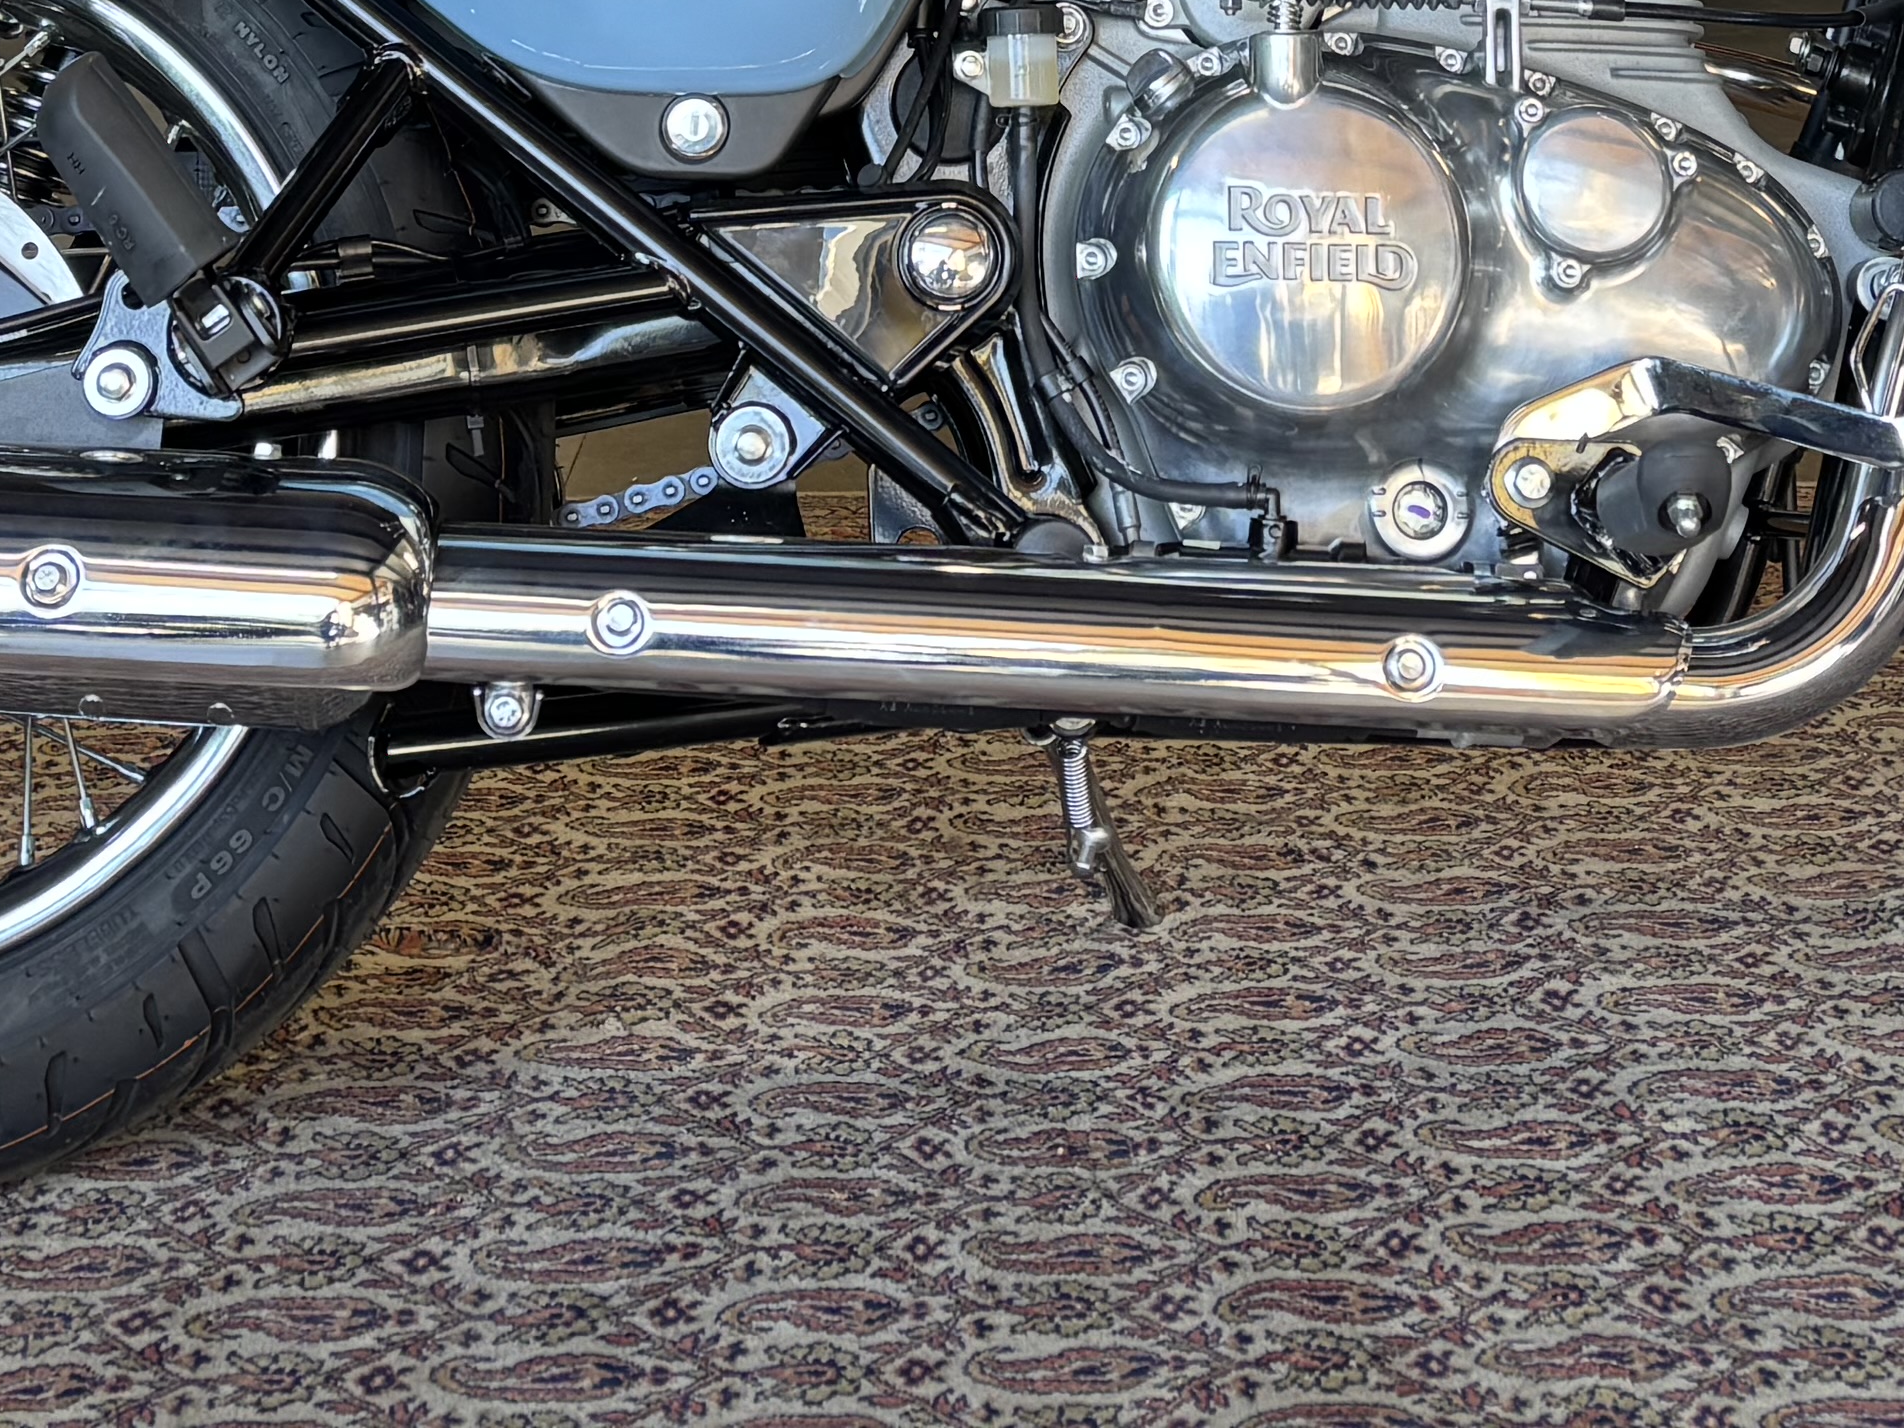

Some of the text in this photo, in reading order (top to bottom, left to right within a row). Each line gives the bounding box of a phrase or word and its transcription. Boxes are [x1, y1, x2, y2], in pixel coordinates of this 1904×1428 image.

[233, 20, 291, 85] NYLON
[1225, 185, 1396, 237] ROYAL
[1209, 239, 1419, 293] ENFIELD
